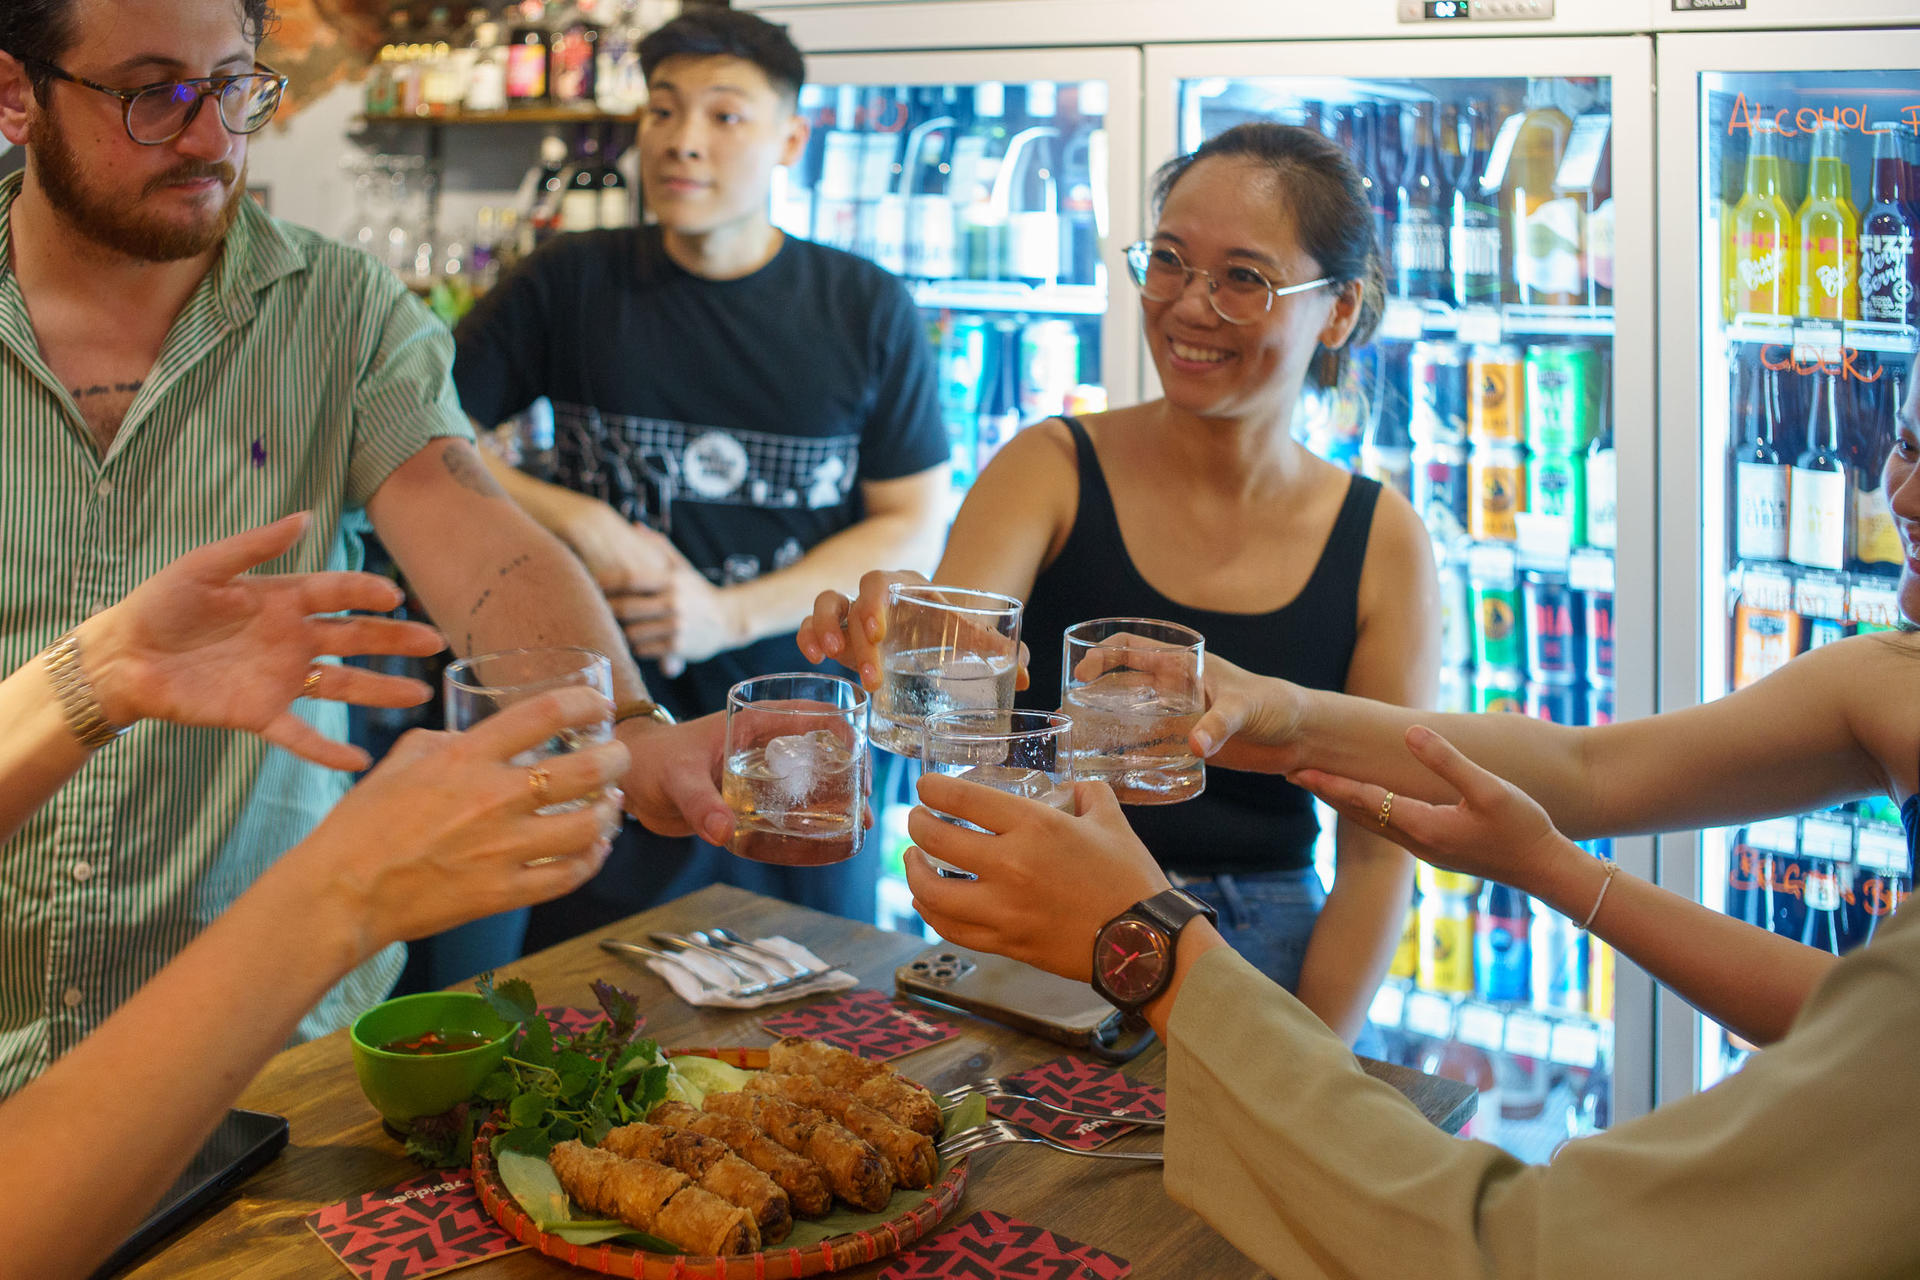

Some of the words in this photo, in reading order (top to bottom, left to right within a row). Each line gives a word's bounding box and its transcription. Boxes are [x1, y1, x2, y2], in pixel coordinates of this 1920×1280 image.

[1728, 91, 1891, 138] ALCOHOL
[1860, 234, 1914, 254] FIZZ
[1760, 343, 1883, 383] CIDER
[385, 1179, 467, 1206] 7Bridges
